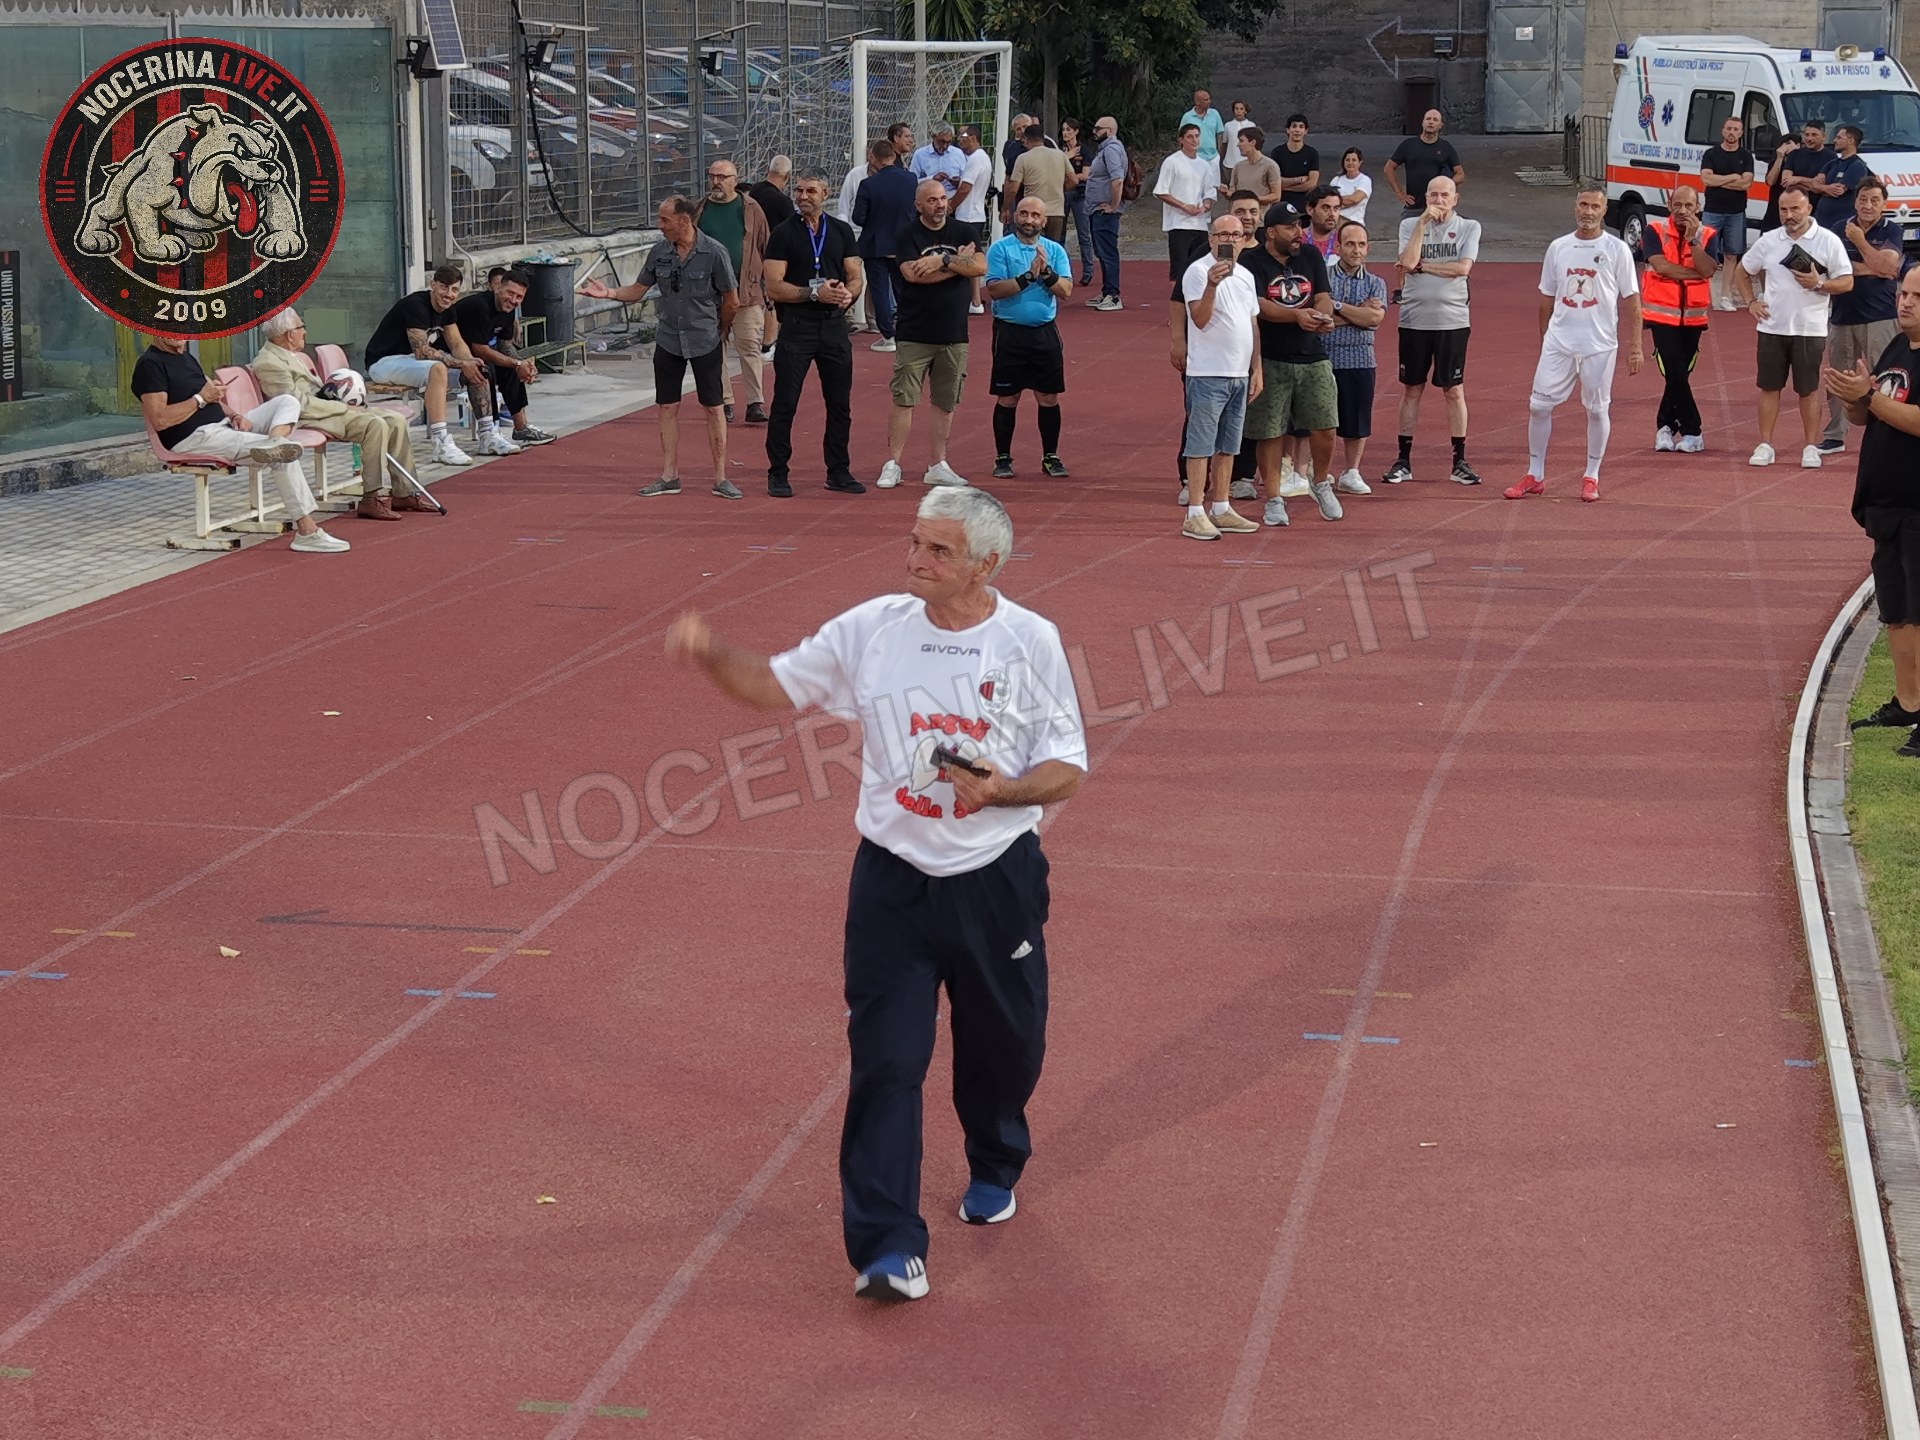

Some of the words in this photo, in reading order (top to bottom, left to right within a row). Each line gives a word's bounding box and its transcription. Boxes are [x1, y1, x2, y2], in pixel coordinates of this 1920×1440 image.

[1825, 64, 1841, 76] SAN
[1843, 64, 1870, 76] PRISCO
[1421, 242, 1458, 259] OCERINA
[1, 270, 14, 297] UNITI
[1, 298, 14, 349] POSSIAMO
[2, 350, 15, 380] TUTTO
[921, 643, 980, 657] GIVOVA
[896, 786, 943, 819] della
